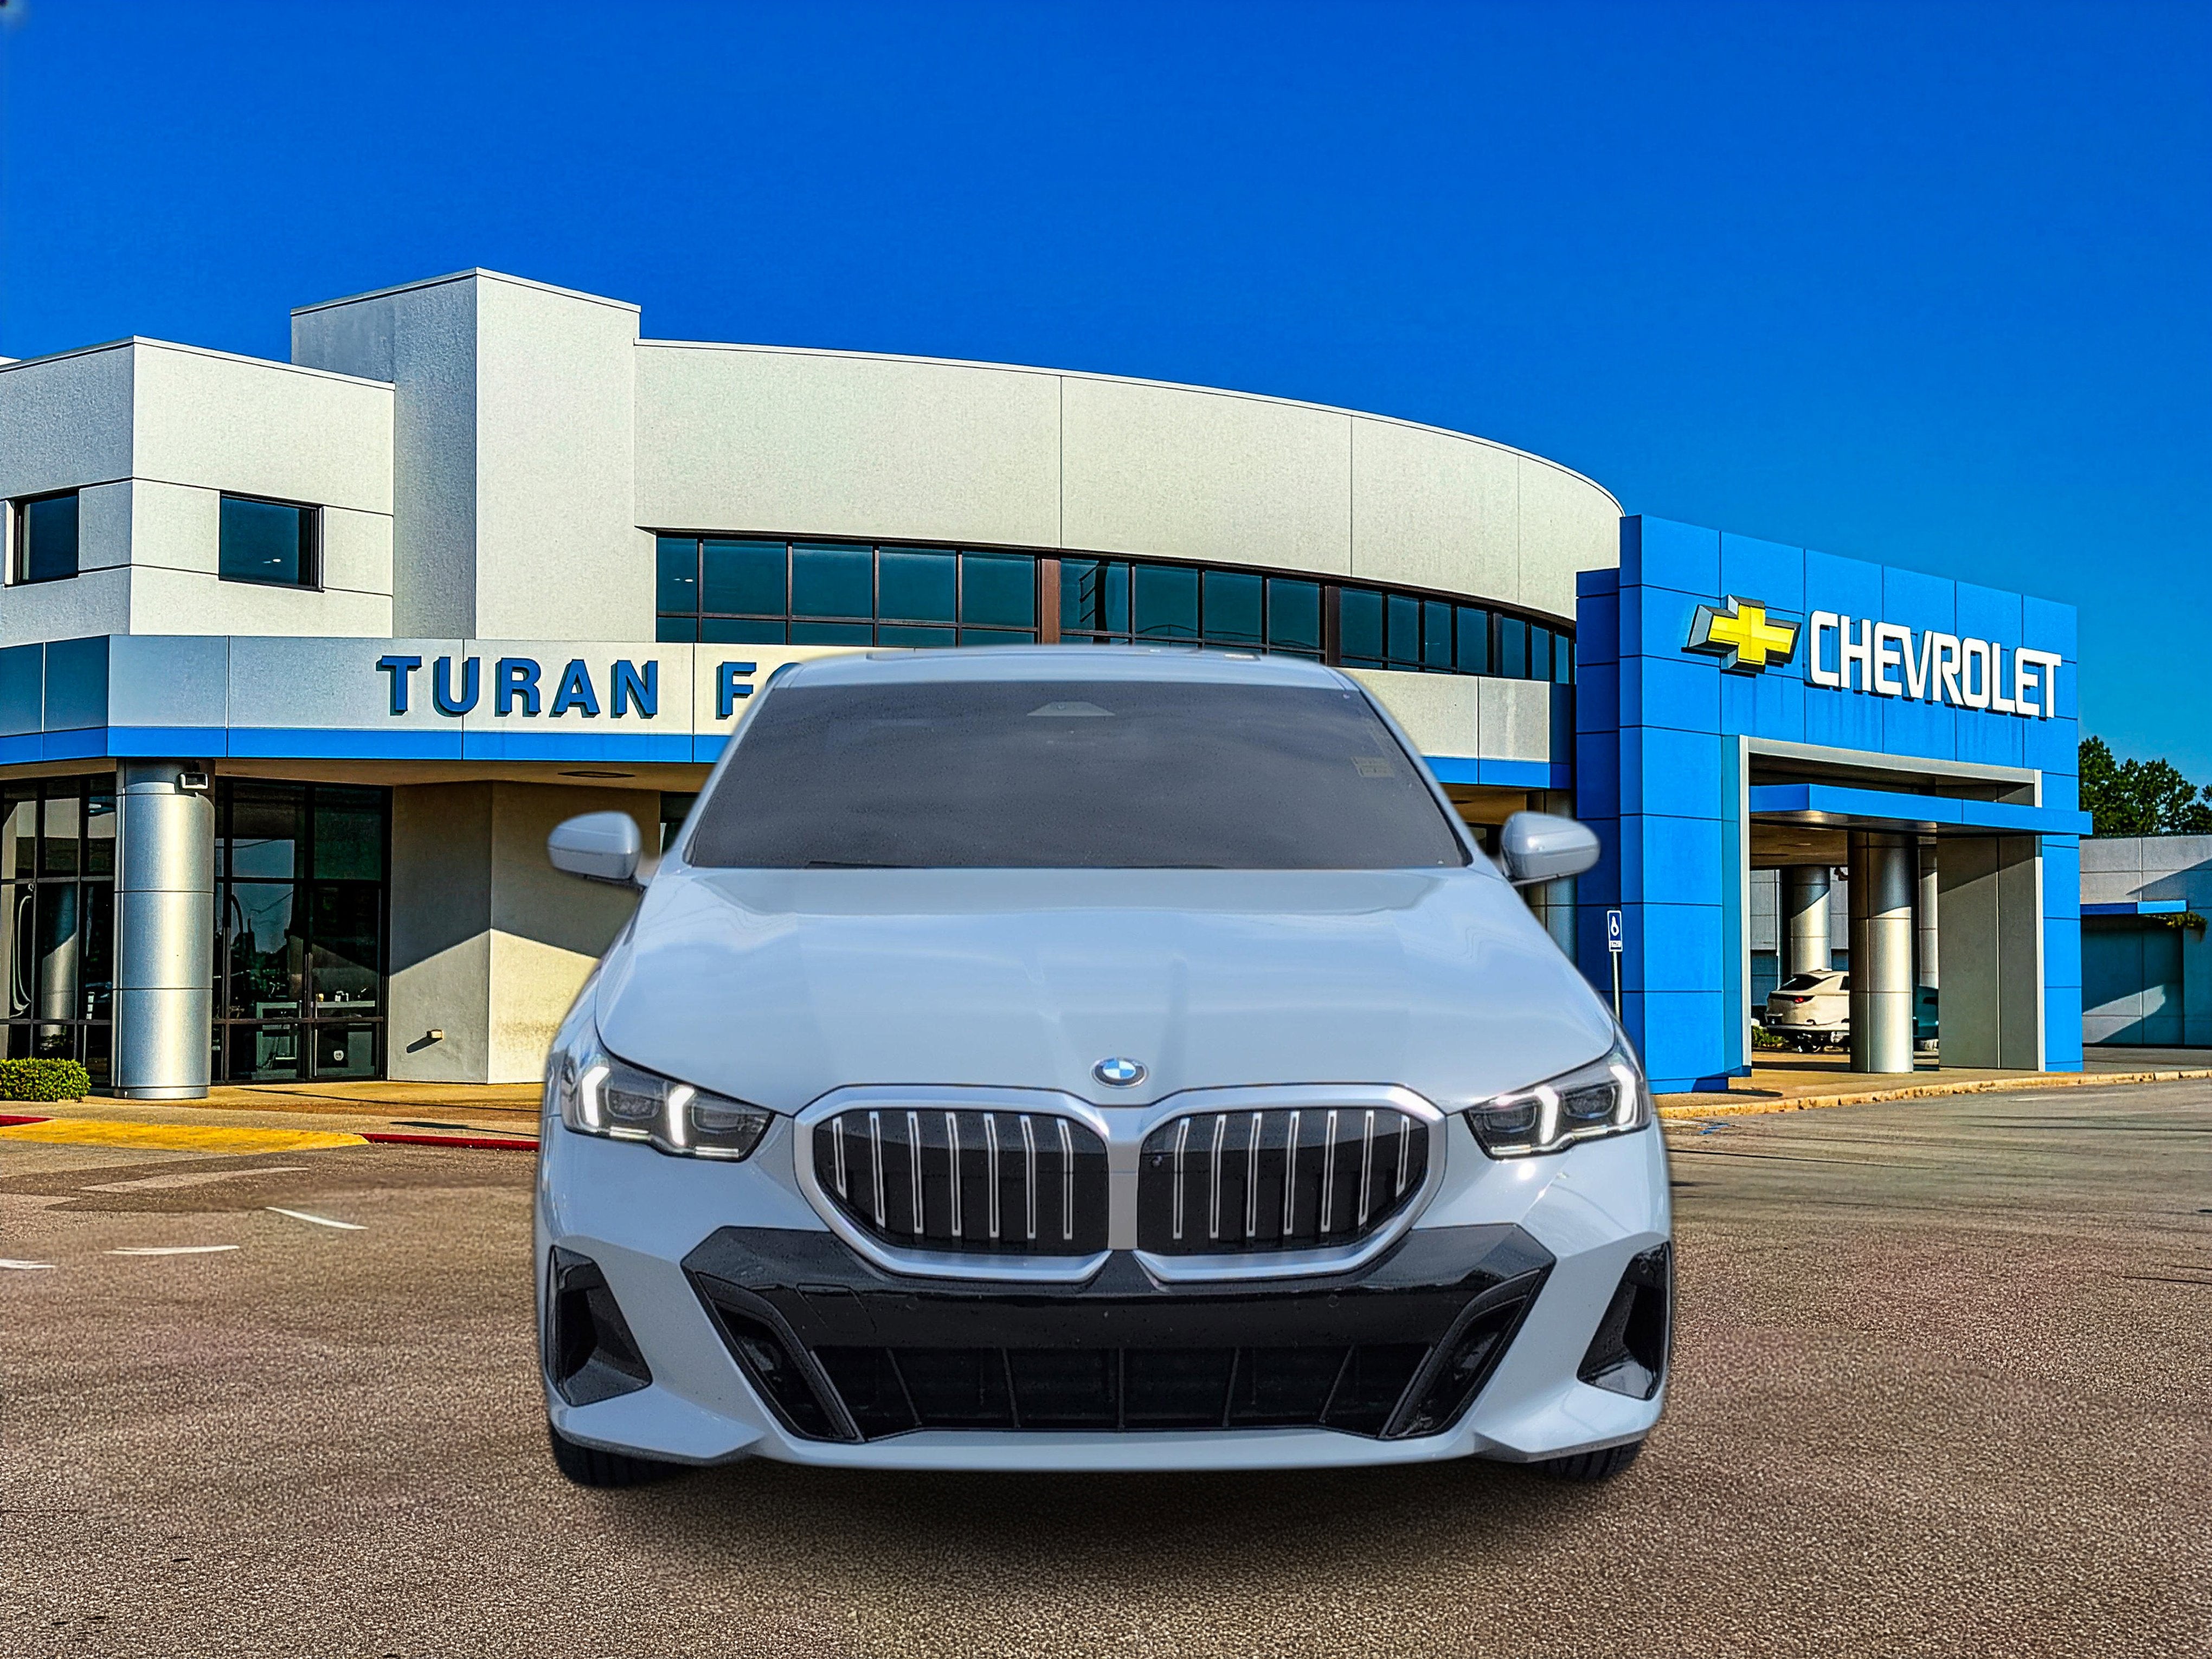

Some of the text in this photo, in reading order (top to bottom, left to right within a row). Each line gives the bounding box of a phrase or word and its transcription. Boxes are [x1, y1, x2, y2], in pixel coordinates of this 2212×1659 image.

[376, 655, 797, 720] TURAN F
[1809, 610, 2062, 719] CHEVROLET
